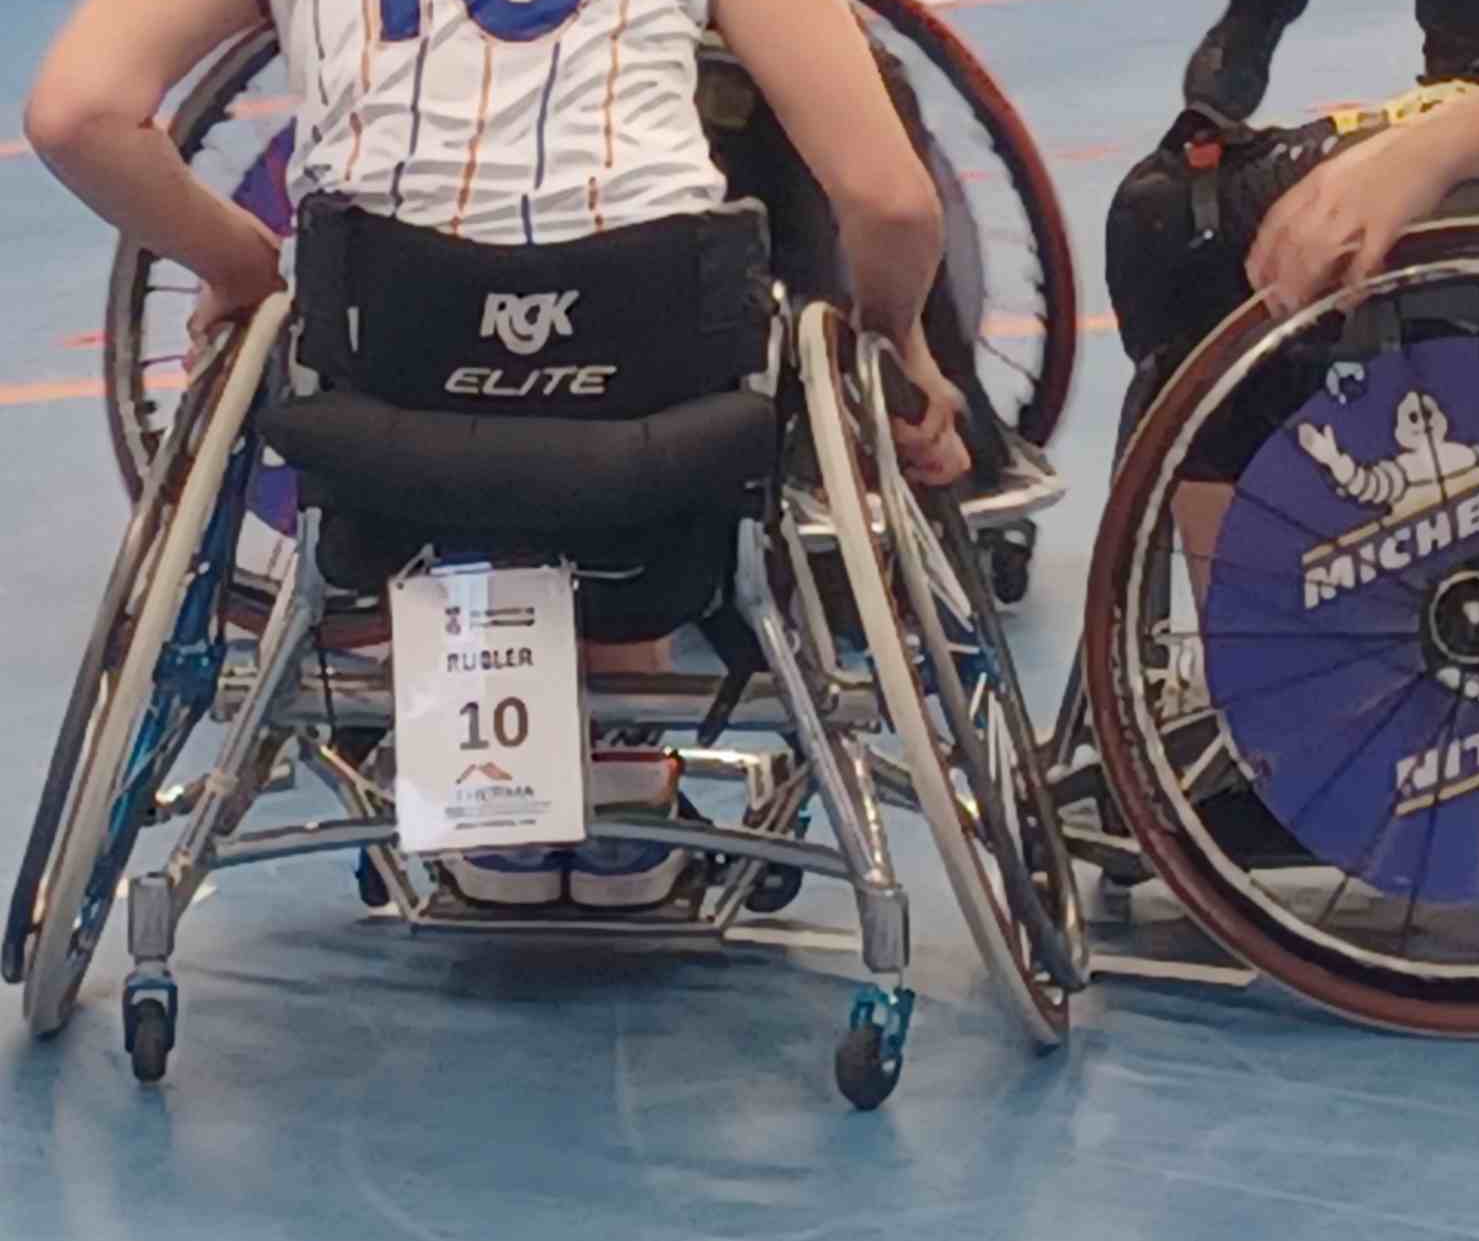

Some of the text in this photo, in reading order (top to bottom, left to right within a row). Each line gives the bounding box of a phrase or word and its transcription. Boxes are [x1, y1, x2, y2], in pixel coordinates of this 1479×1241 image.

[480, 289, 580, 355] RGK
[445, 365, 617, 396] ELITE
[458, 696, 529, 750] 10
